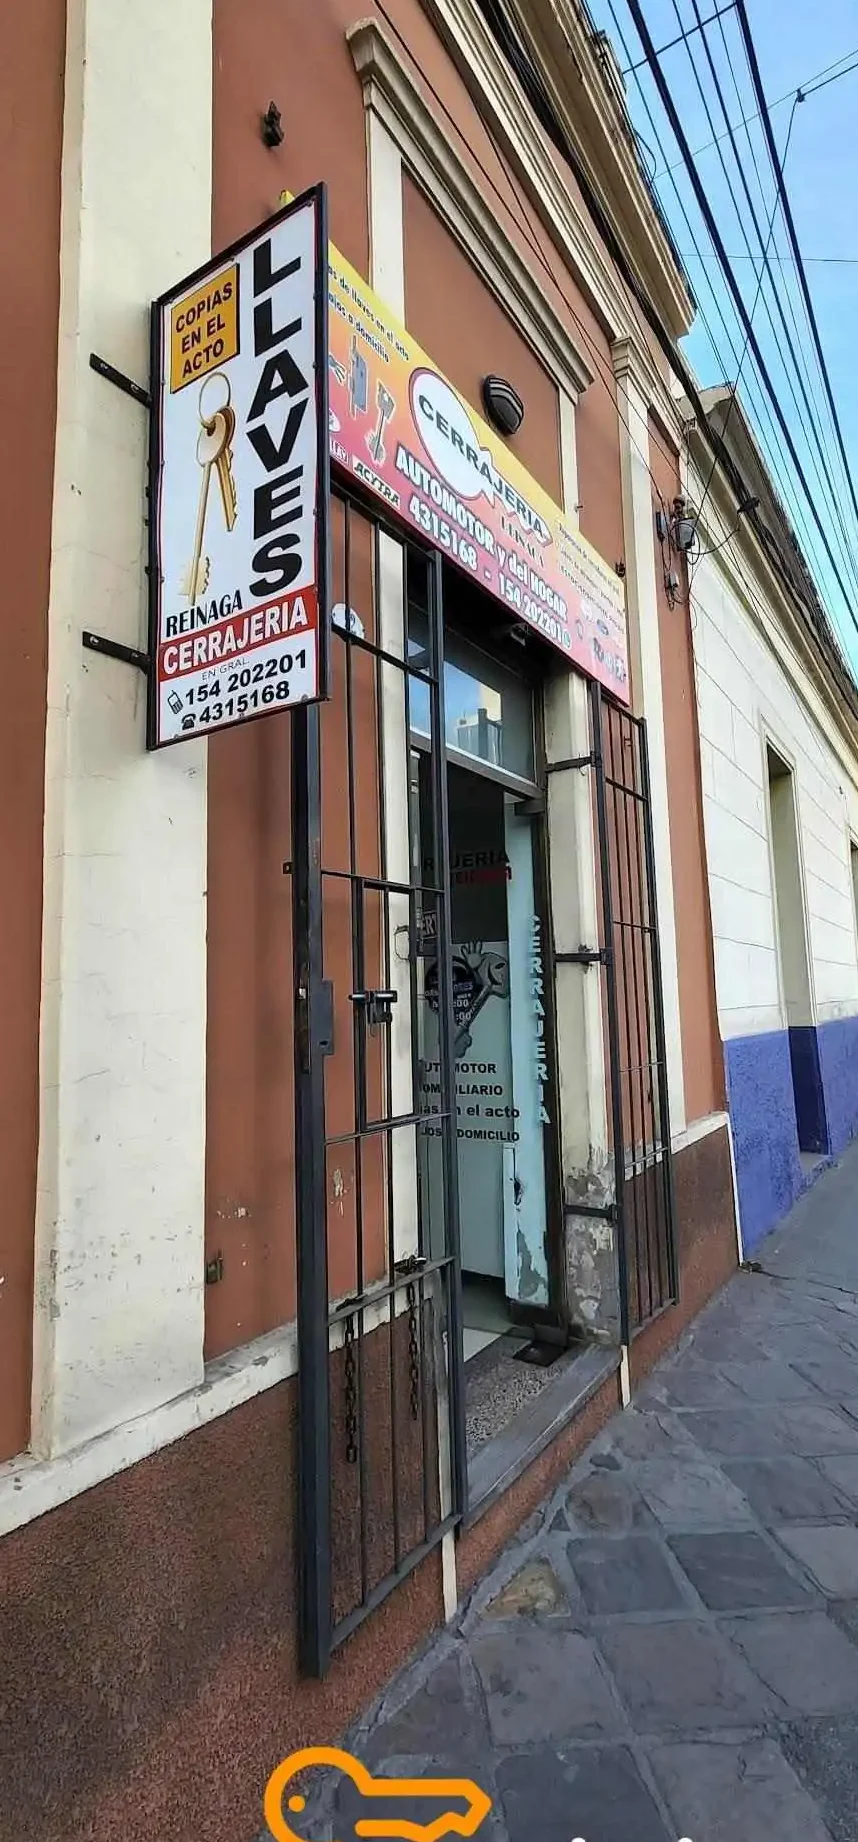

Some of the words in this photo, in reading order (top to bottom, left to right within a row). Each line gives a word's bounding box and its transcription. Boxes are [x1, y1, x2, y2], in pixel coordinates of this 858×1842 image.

[175, 281, 232, 333] COPIAS
[181, 327, 201, 355] EN
[206, 313, 226, 336] EL
[181, 338, 225, 379] ACTO
[246, 238, 309, 597] LLAVES
[353, 461, 400, 507] ACYTRA
[418, 394, 546, 538] CERRAJERIA
[394, 443, 496, 556] AUTOMOTOR
[498, 545, 506, 568] y
[508, 549, 529, 586] del
[530, 566, 568, 622] HOGAR
[408, 495, 478, 572] 4315168
[498, 572, 521, 609] 154
[523, 594, 562, 645] 202201
[163, 596, 308, 676] CERRAJERIA
[166, 590, 243, 638] REINAGA
[185, 679, 221, 706] 154
[228, 649, 307, 693] 202201
[202, 668, 217, 681] EN
[199, 680, 291, 724] 4315168
[528, 914, 552, 1125] CERRAJERIA
[457, 1129, 520, 1142] DOMICILIO
[467, 1104, 480, 1117] el
[485, 1105, 520, 1119] acto
